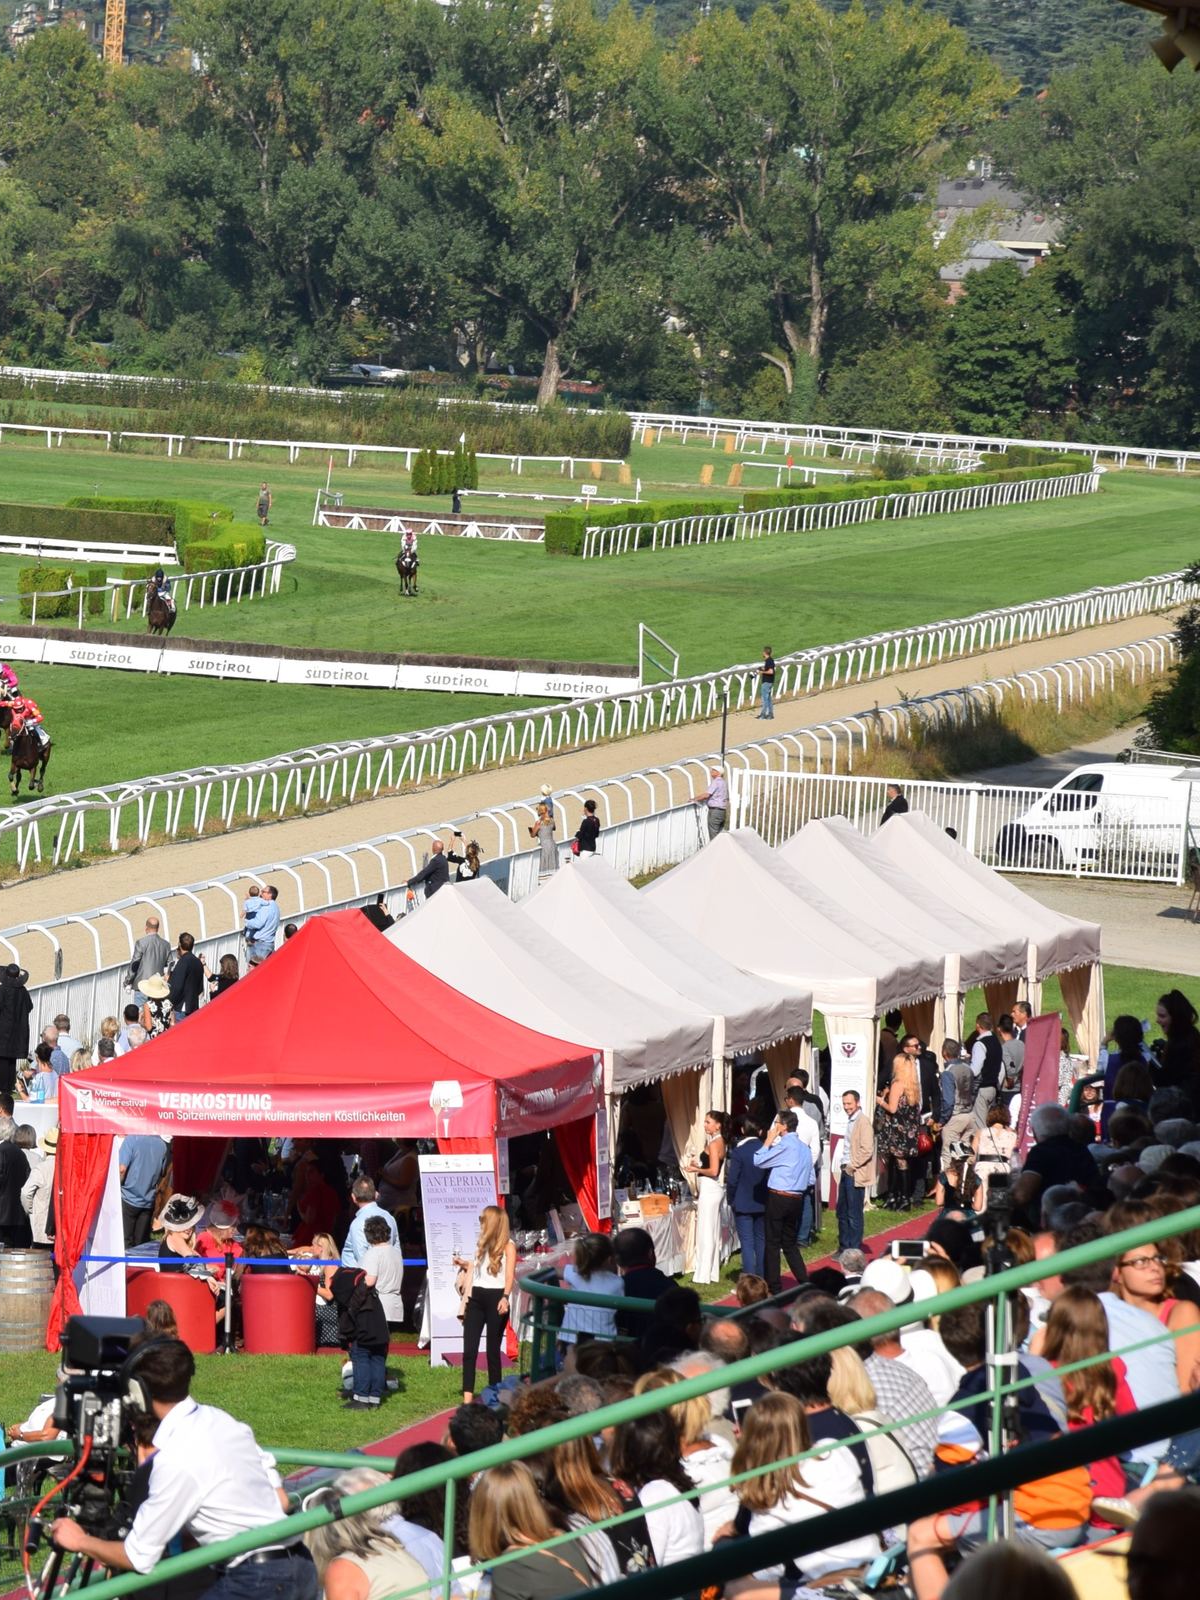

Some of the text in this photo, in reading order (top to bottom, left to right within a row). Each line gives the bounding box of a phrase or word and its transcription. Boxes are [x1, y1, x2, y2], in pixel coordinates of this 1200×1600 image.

[94, 1089, 121, 1097] Meran
[94, 1097, 147, 1107] WineFestival
[158, 1092, 272, 1110] VERKOSTUNG
[158, 1111, 174, 1121] von
[177, 1110, 242, 1122] Spitzenweinen
[244, 1110, 262, 1121] und
[264, 1110, 332, 1122] kulinarischen
[334, 1110, 406, 1122] Köstlichkeiten
[426, 1175, 492, 1187] ANTEPRIMA
